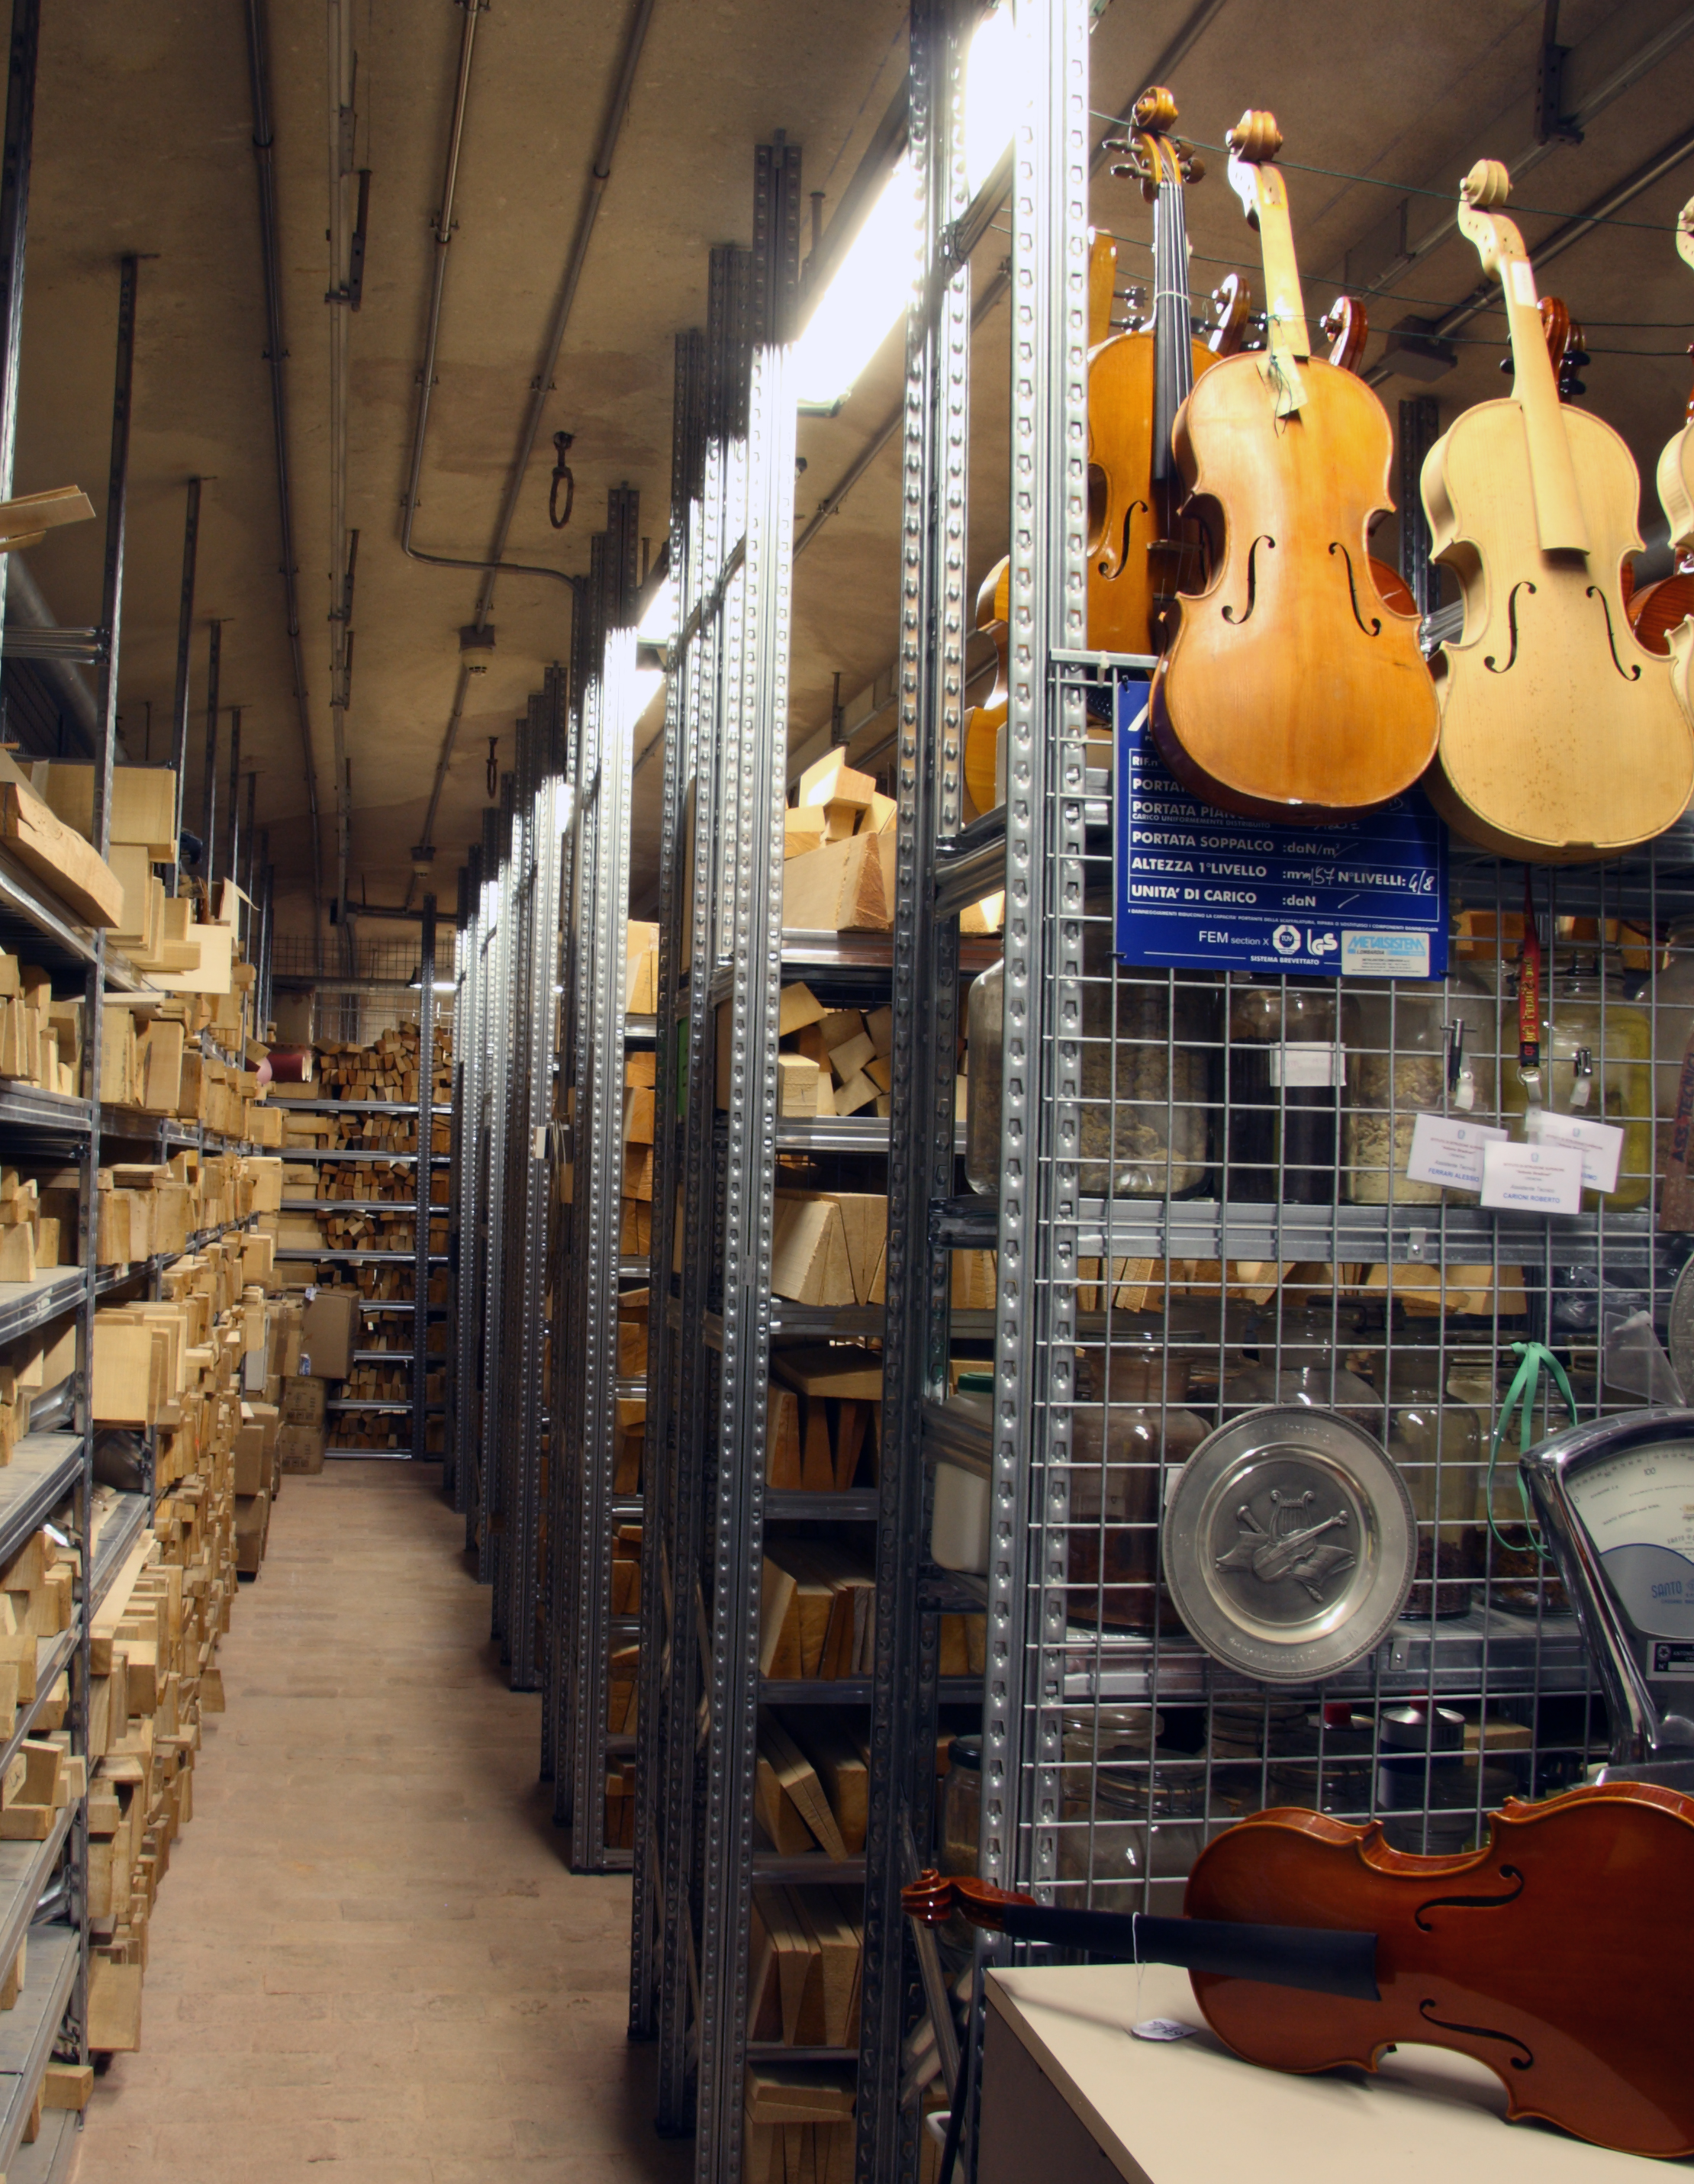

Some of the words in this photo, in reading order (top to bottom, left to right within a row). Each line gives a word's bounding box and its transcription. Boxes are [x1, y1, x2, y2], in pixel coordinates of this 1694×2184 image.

[1133, 801, 1196, 817] PORTATA
[1132, 813, 1159, 821] CARICO
[1161, 816, 1223, 826] UNIFORMEMENTE
[1132, 831, 1196, 846] PORTATA
[1200, 836, 1274, 852] SOPPALCO
[1132, 857, 1194, 872] ALTEZZA
[1184, 887, 1200, 900] DI
[1204, 890, 1257, 904] CARICO
[1199, 930, 1229, 943] FEM
[1231, 937, 1260, 945] section
[1280, 957, 1320, 965] BREVETTATO
[1530, 1195, 1560, 1203] ROBERTO
[1644, 1467, 1656, 1476] 100
[1651, 1580, 1683, 1599] SANTO
